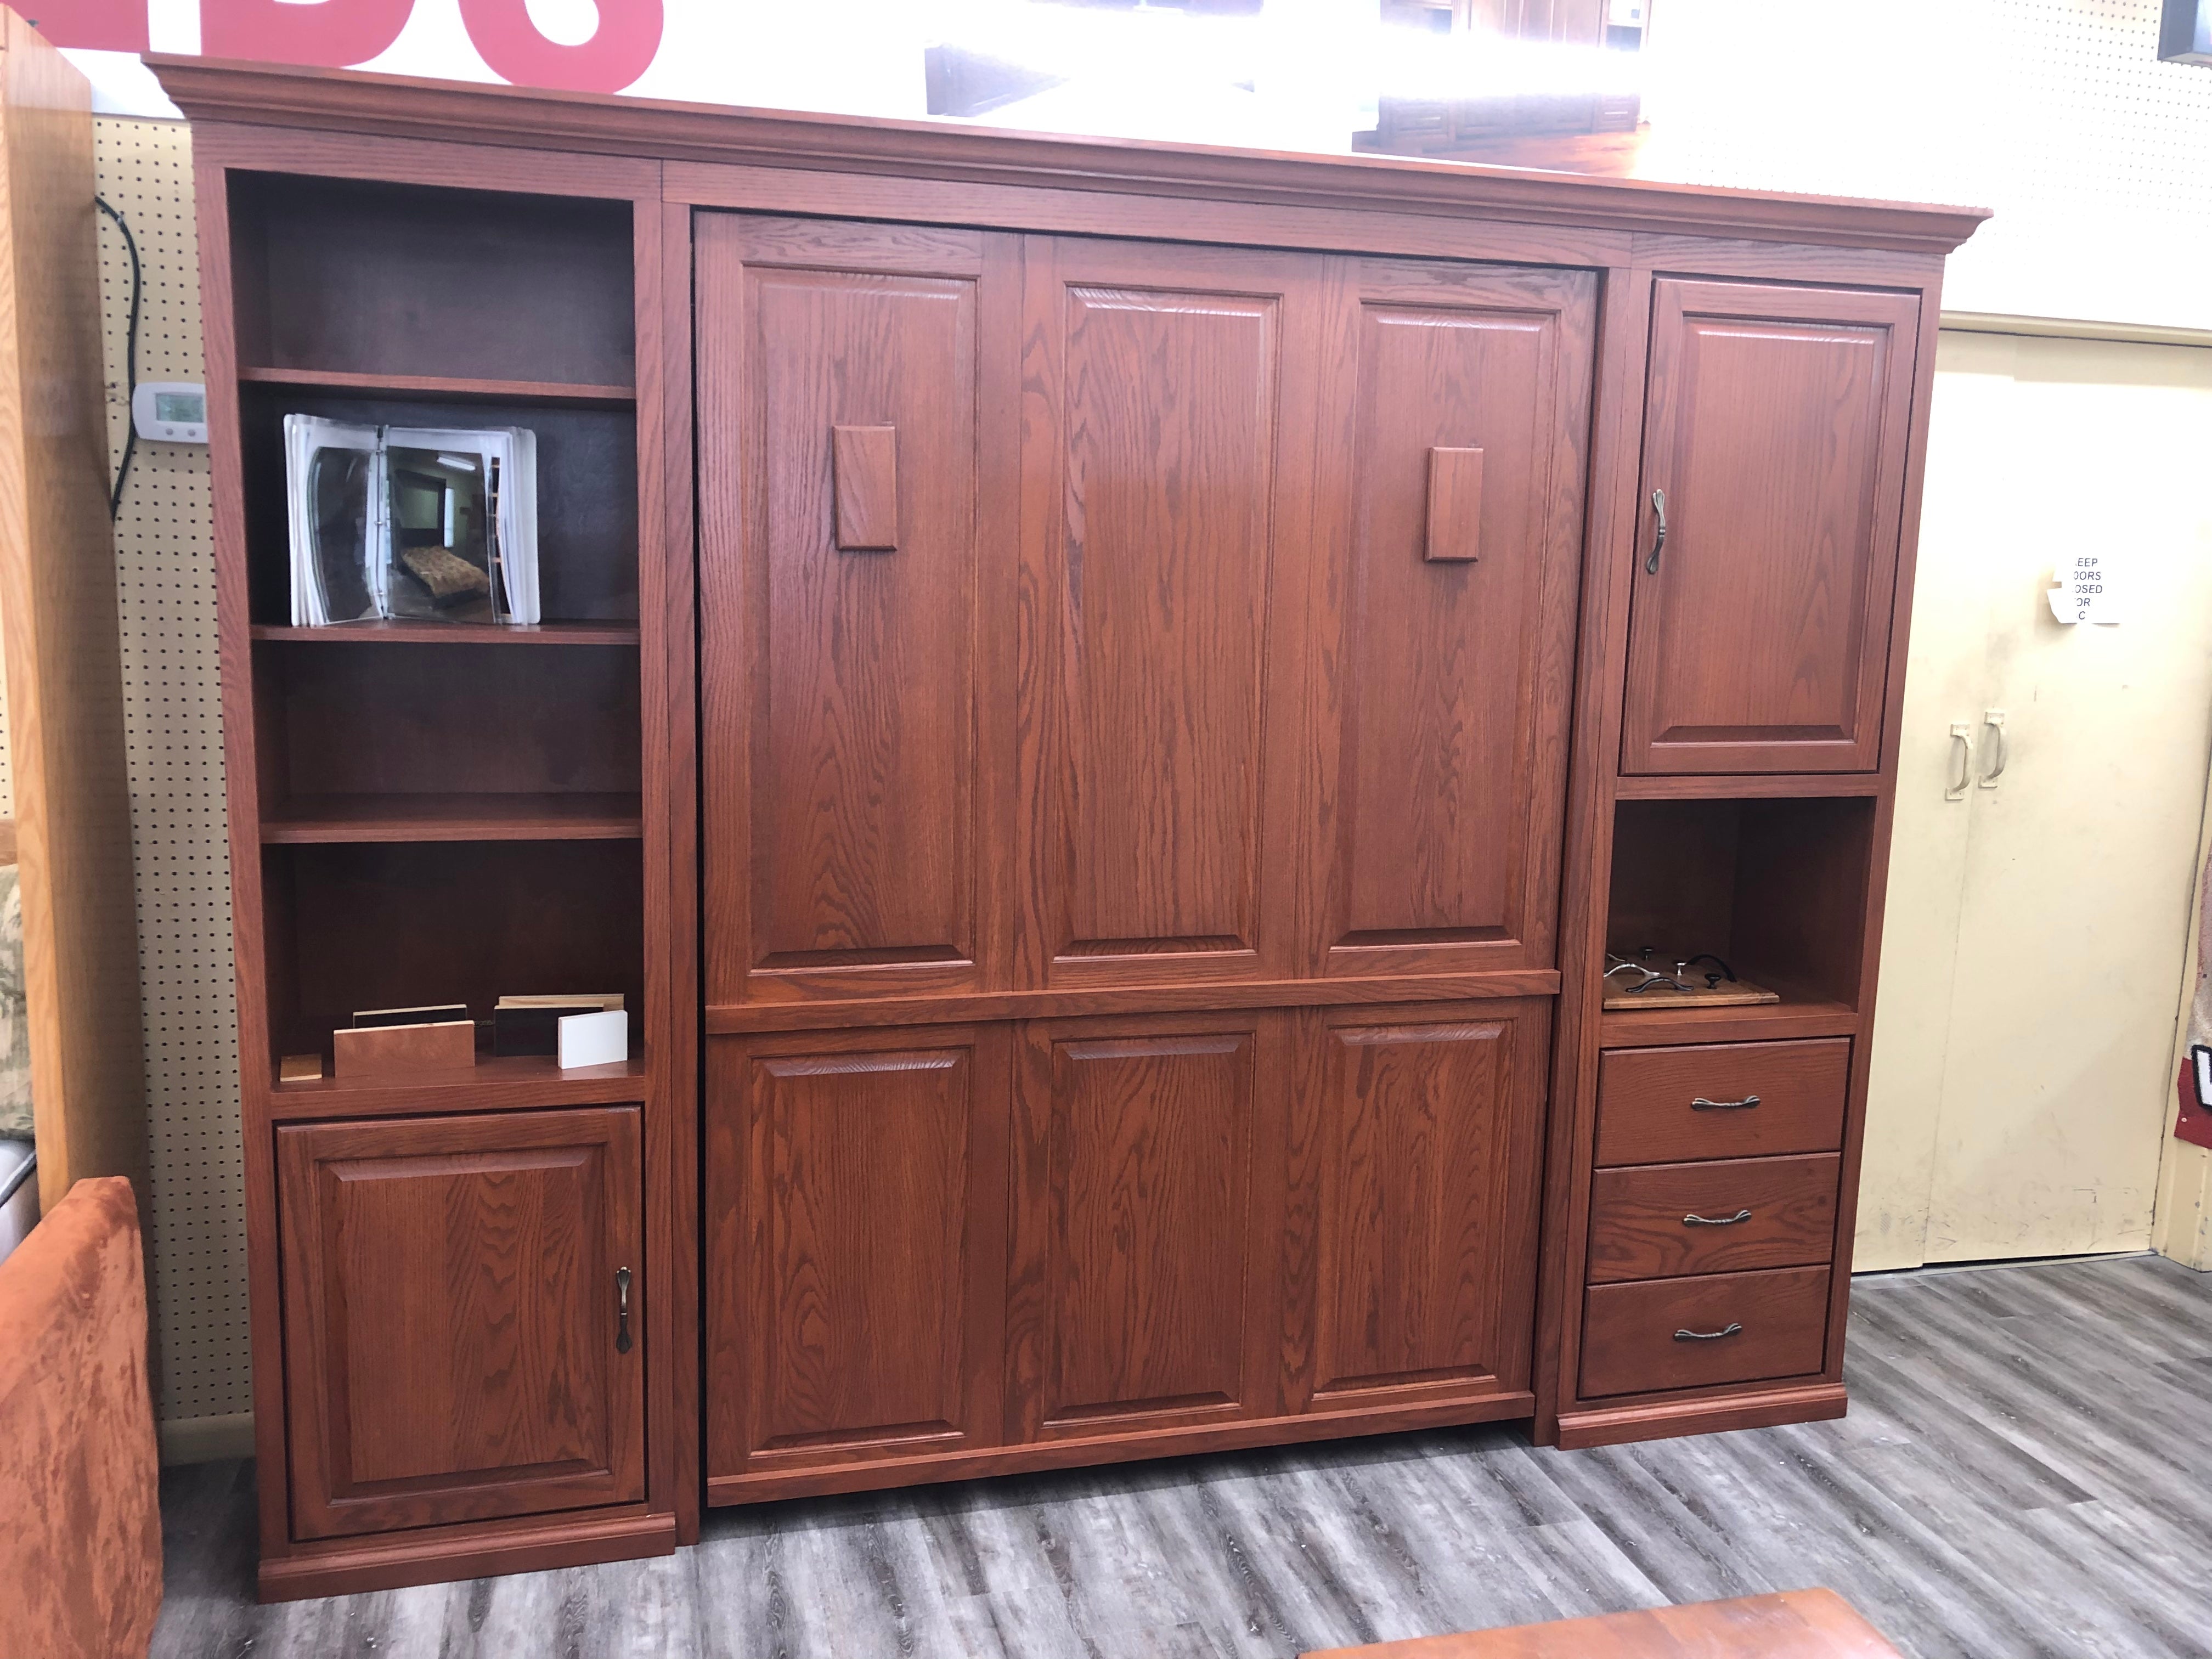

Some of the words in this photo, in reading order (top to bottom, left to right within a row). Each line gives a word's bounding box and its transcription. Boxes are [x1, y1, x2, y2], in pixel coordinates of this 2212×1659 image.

[2075, 557, 2098, 567] EEP
[2073, 571, 2101, 580] OORS
[2072, 584, 2103, 594] OSED
[2074, 597, 2091, 607] OR
